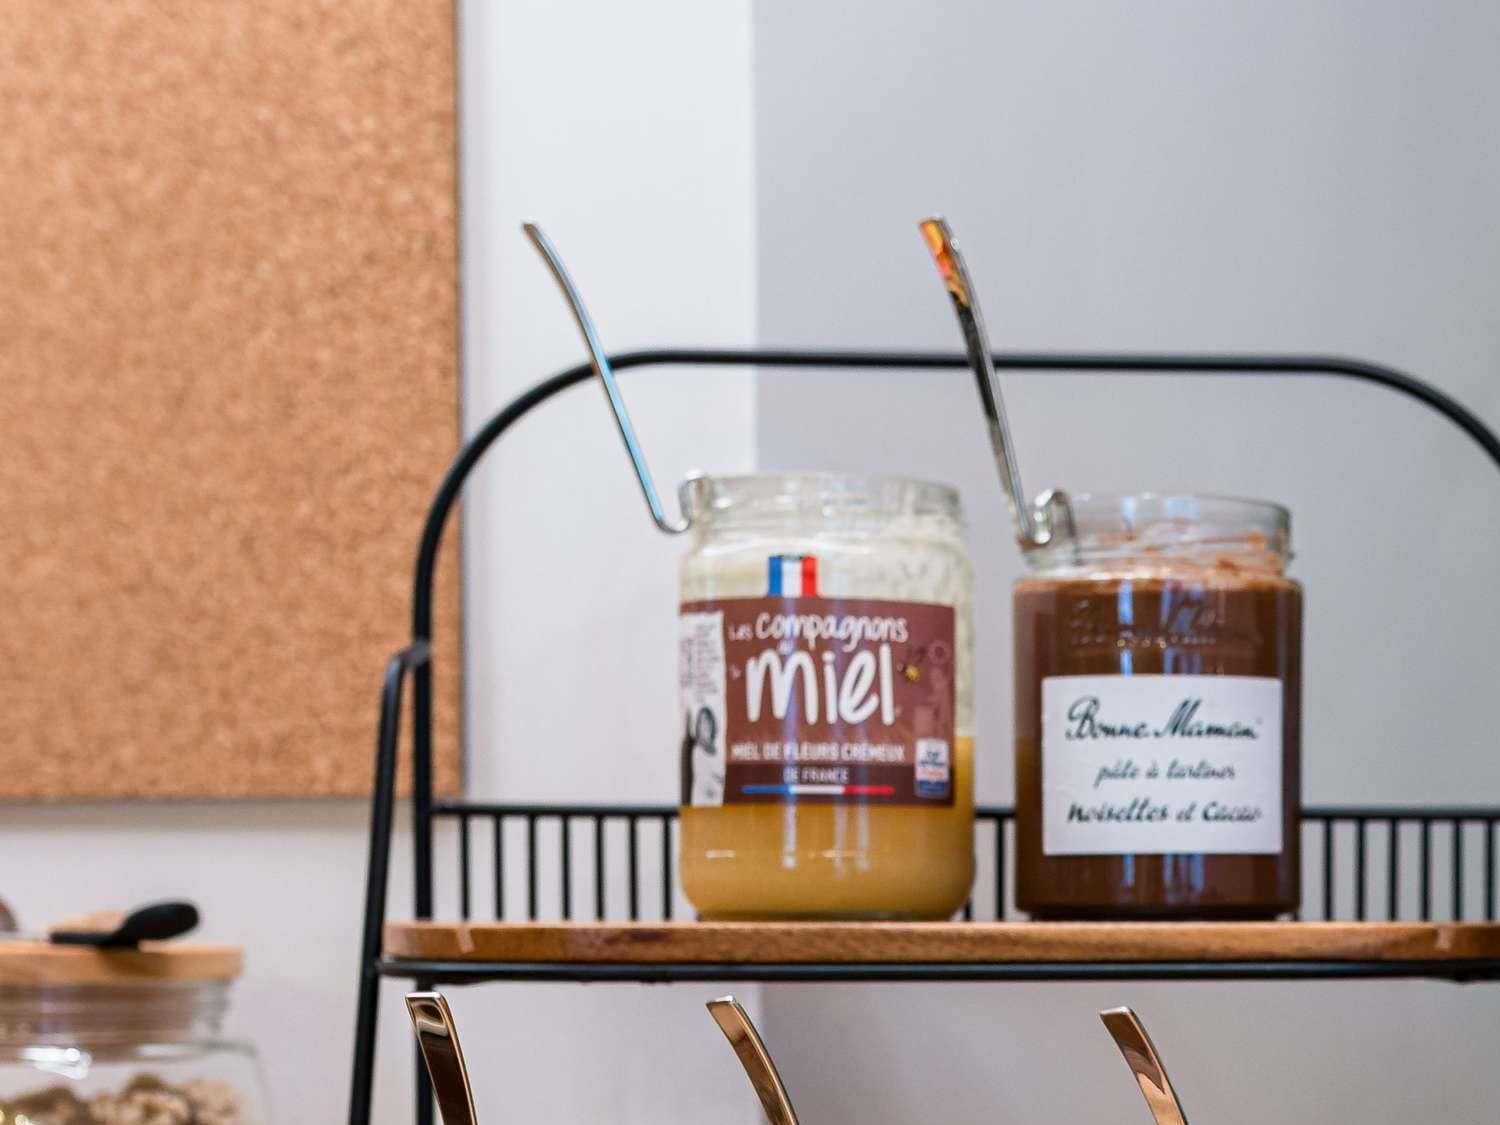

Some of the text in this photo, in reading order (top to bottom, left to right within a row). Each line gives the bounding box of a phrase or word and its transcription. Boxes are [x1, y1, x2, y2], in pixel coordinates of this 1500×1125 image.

[754, 611, 909, 652] Compagnons
[1065, 695, 1260, 741] Bonne Maman
[1175, 801, 1198, 823] et
